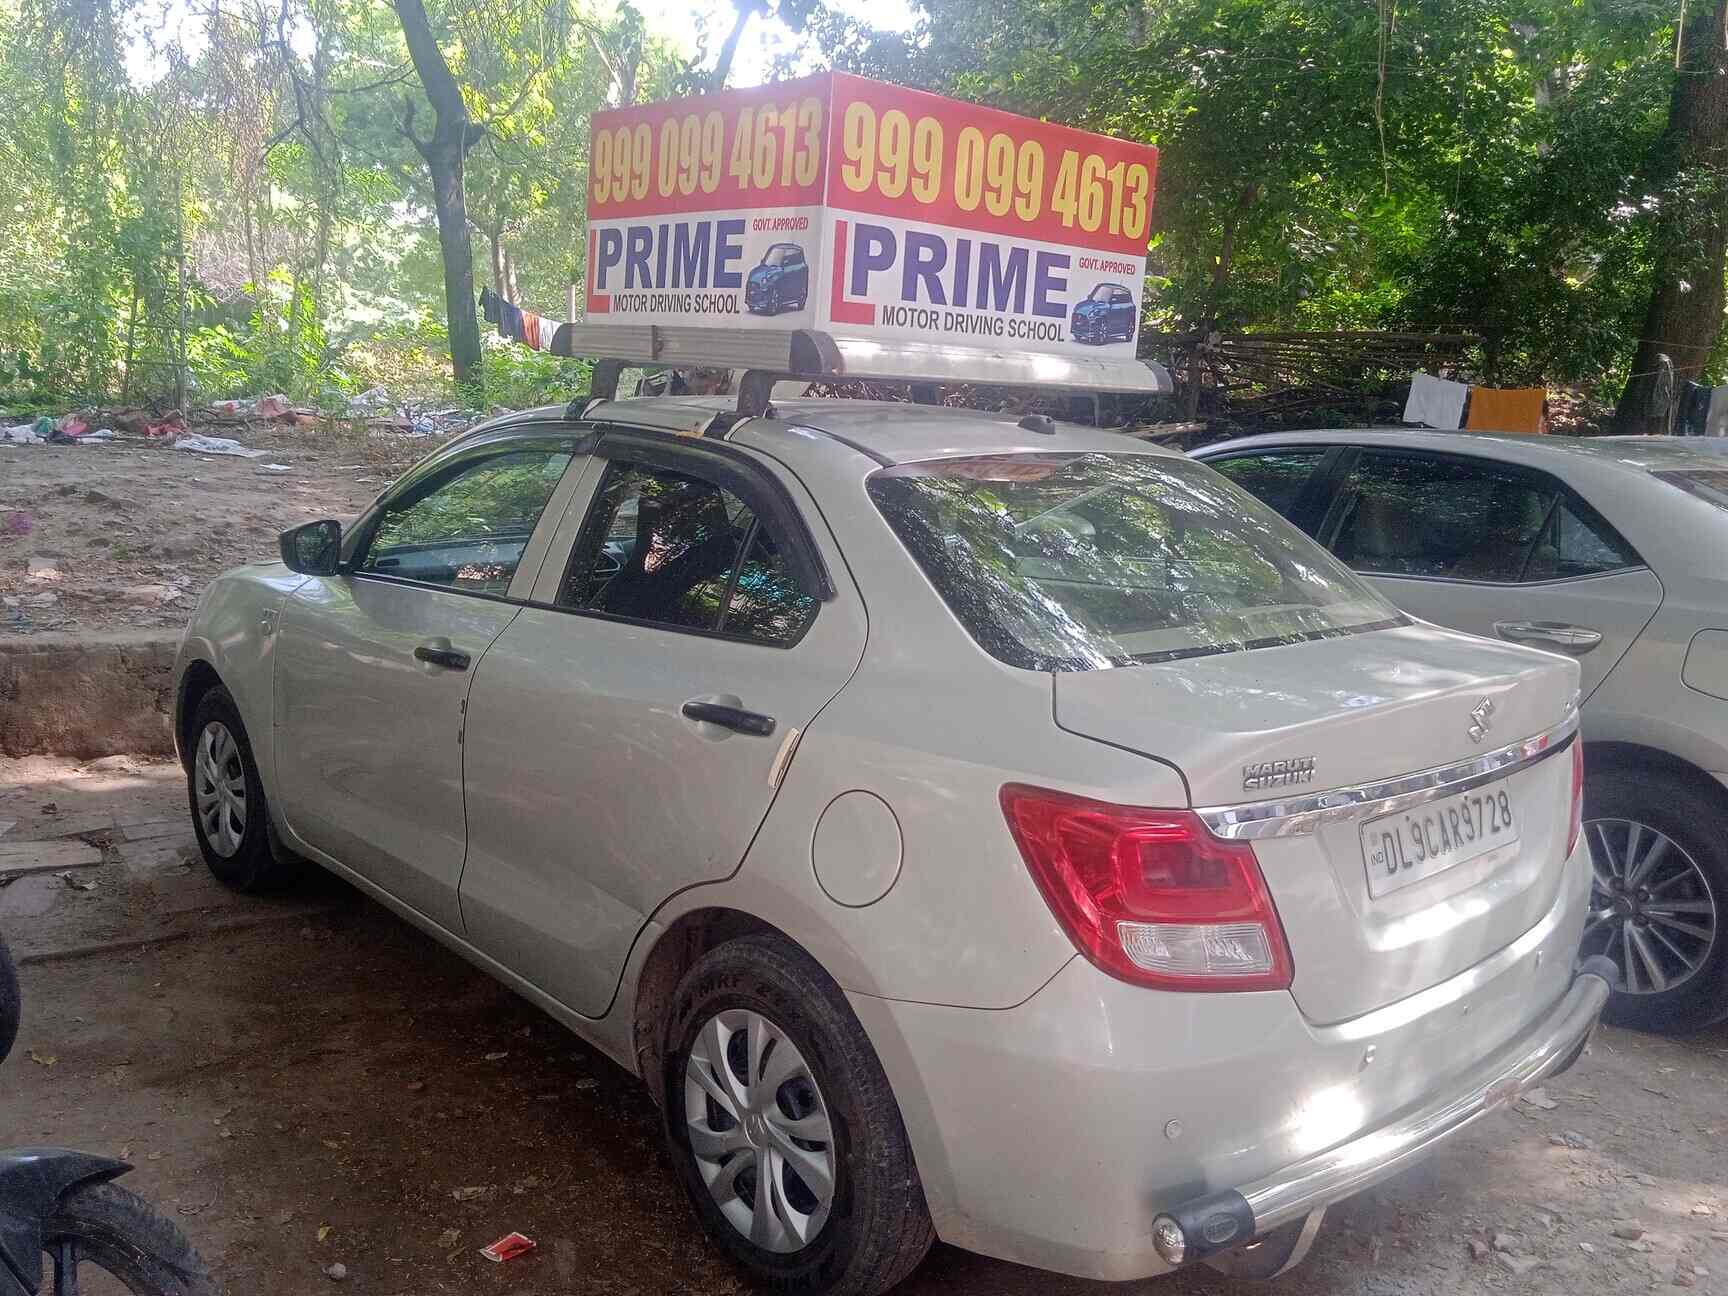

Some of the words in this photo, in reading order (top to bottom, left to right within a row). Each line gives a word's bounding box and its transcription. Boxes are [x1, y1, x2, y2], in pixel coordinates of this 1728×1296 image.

[593, 124, 652, 204] 999
[658, 110, 724, 198] 099
[730, 97, 822, 190] 4613
[841, 101, 944, 204] 999
[954, 126, 1044, 222] 099
[1051, 149, 1149, 240] 4613
[772, 216, 808, 231] APPROVED
[597, 219, 746, 289] PRIME
[830, 220, 876, 325] L
[850, 222, 1071, 319] PRIME
[1099, 260, 1136, 275] APPROVED
[613, 293, 647, 313] MOTOR
[650, 294, 691, 313] DRIVING
[694, 294, 740, 314] SCHOOL
[882, 305, 939, 331] MOTOR
[944, 312, 1004, 337] DRIVING
[1008, 318, 1065, 343] SCHOOL
[1242, 757, 1316, 777] MARUTI
[1242, 769, 1316, 792] SUZUKI
